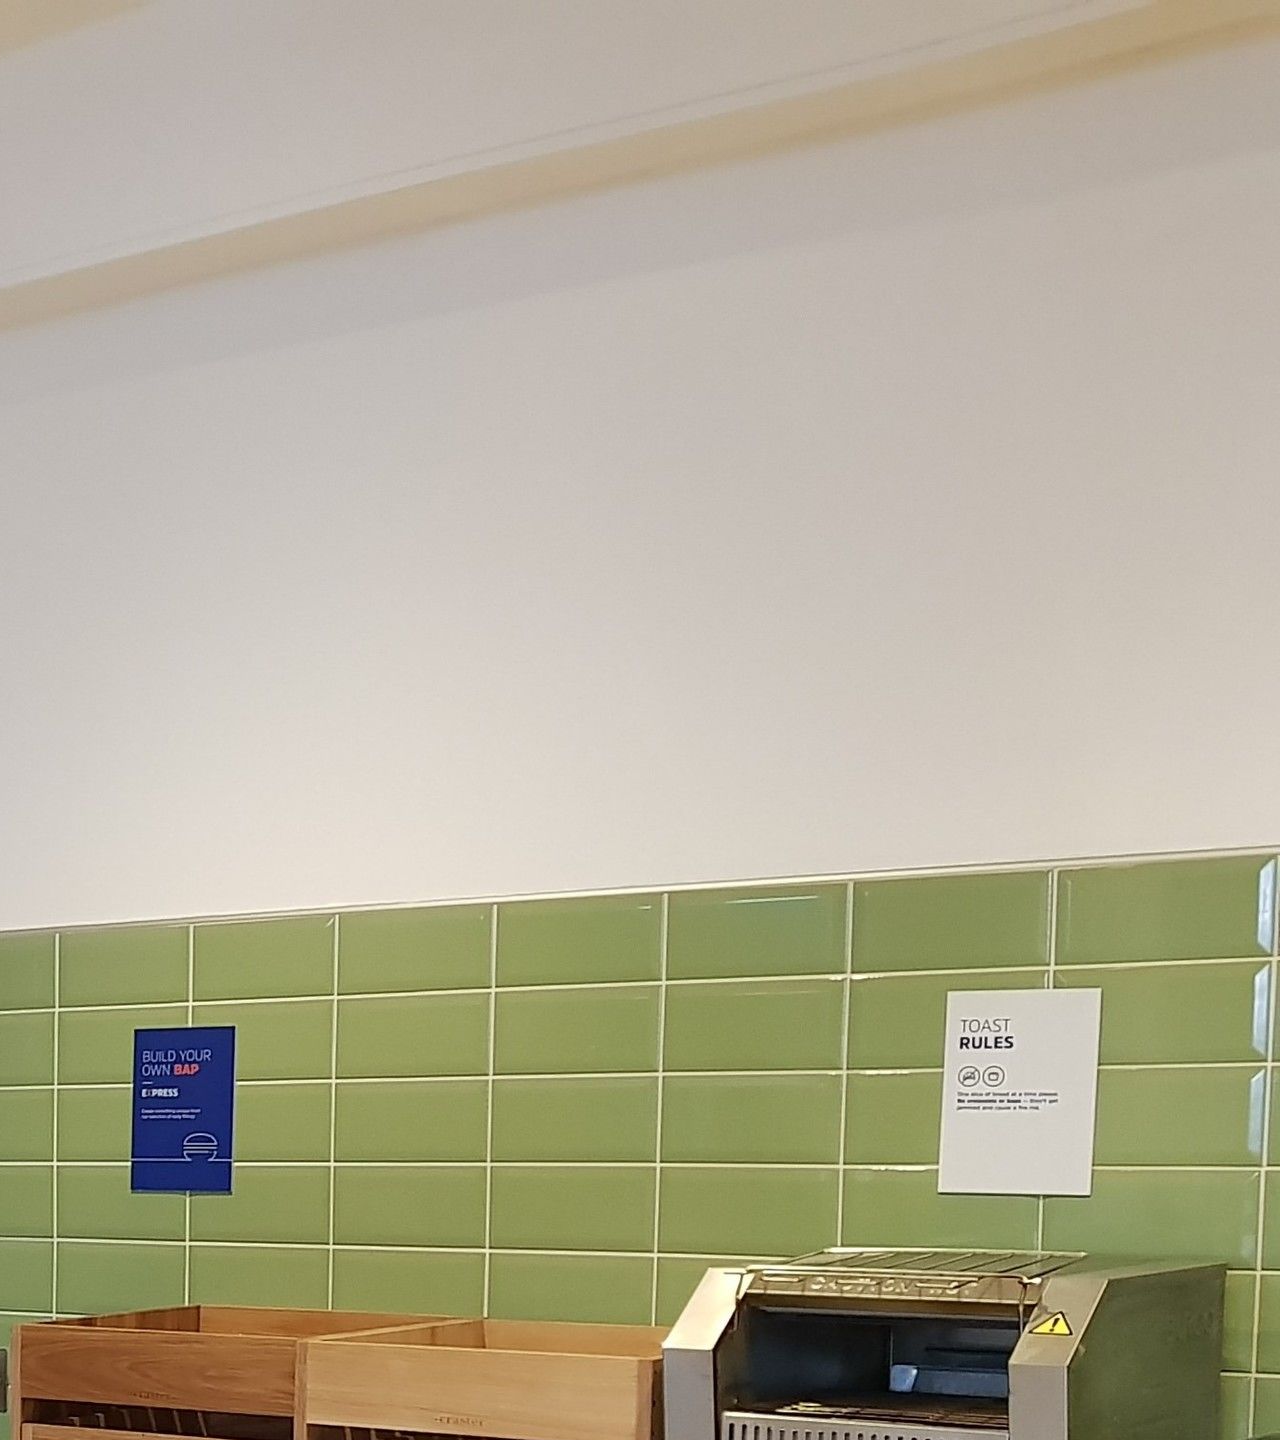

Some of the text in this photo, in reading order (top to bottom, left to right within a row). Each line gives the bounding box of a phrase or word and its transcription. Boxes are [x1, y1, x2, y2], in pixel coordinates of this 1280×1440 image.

[960, 1018, 1011, 1033] TOAST
[959, 1036, 1014, 1050] RULES
[142, 1049, 212, 1063] BUILD YOUR
[142, 1063, 200, 1076] OWN BAP
